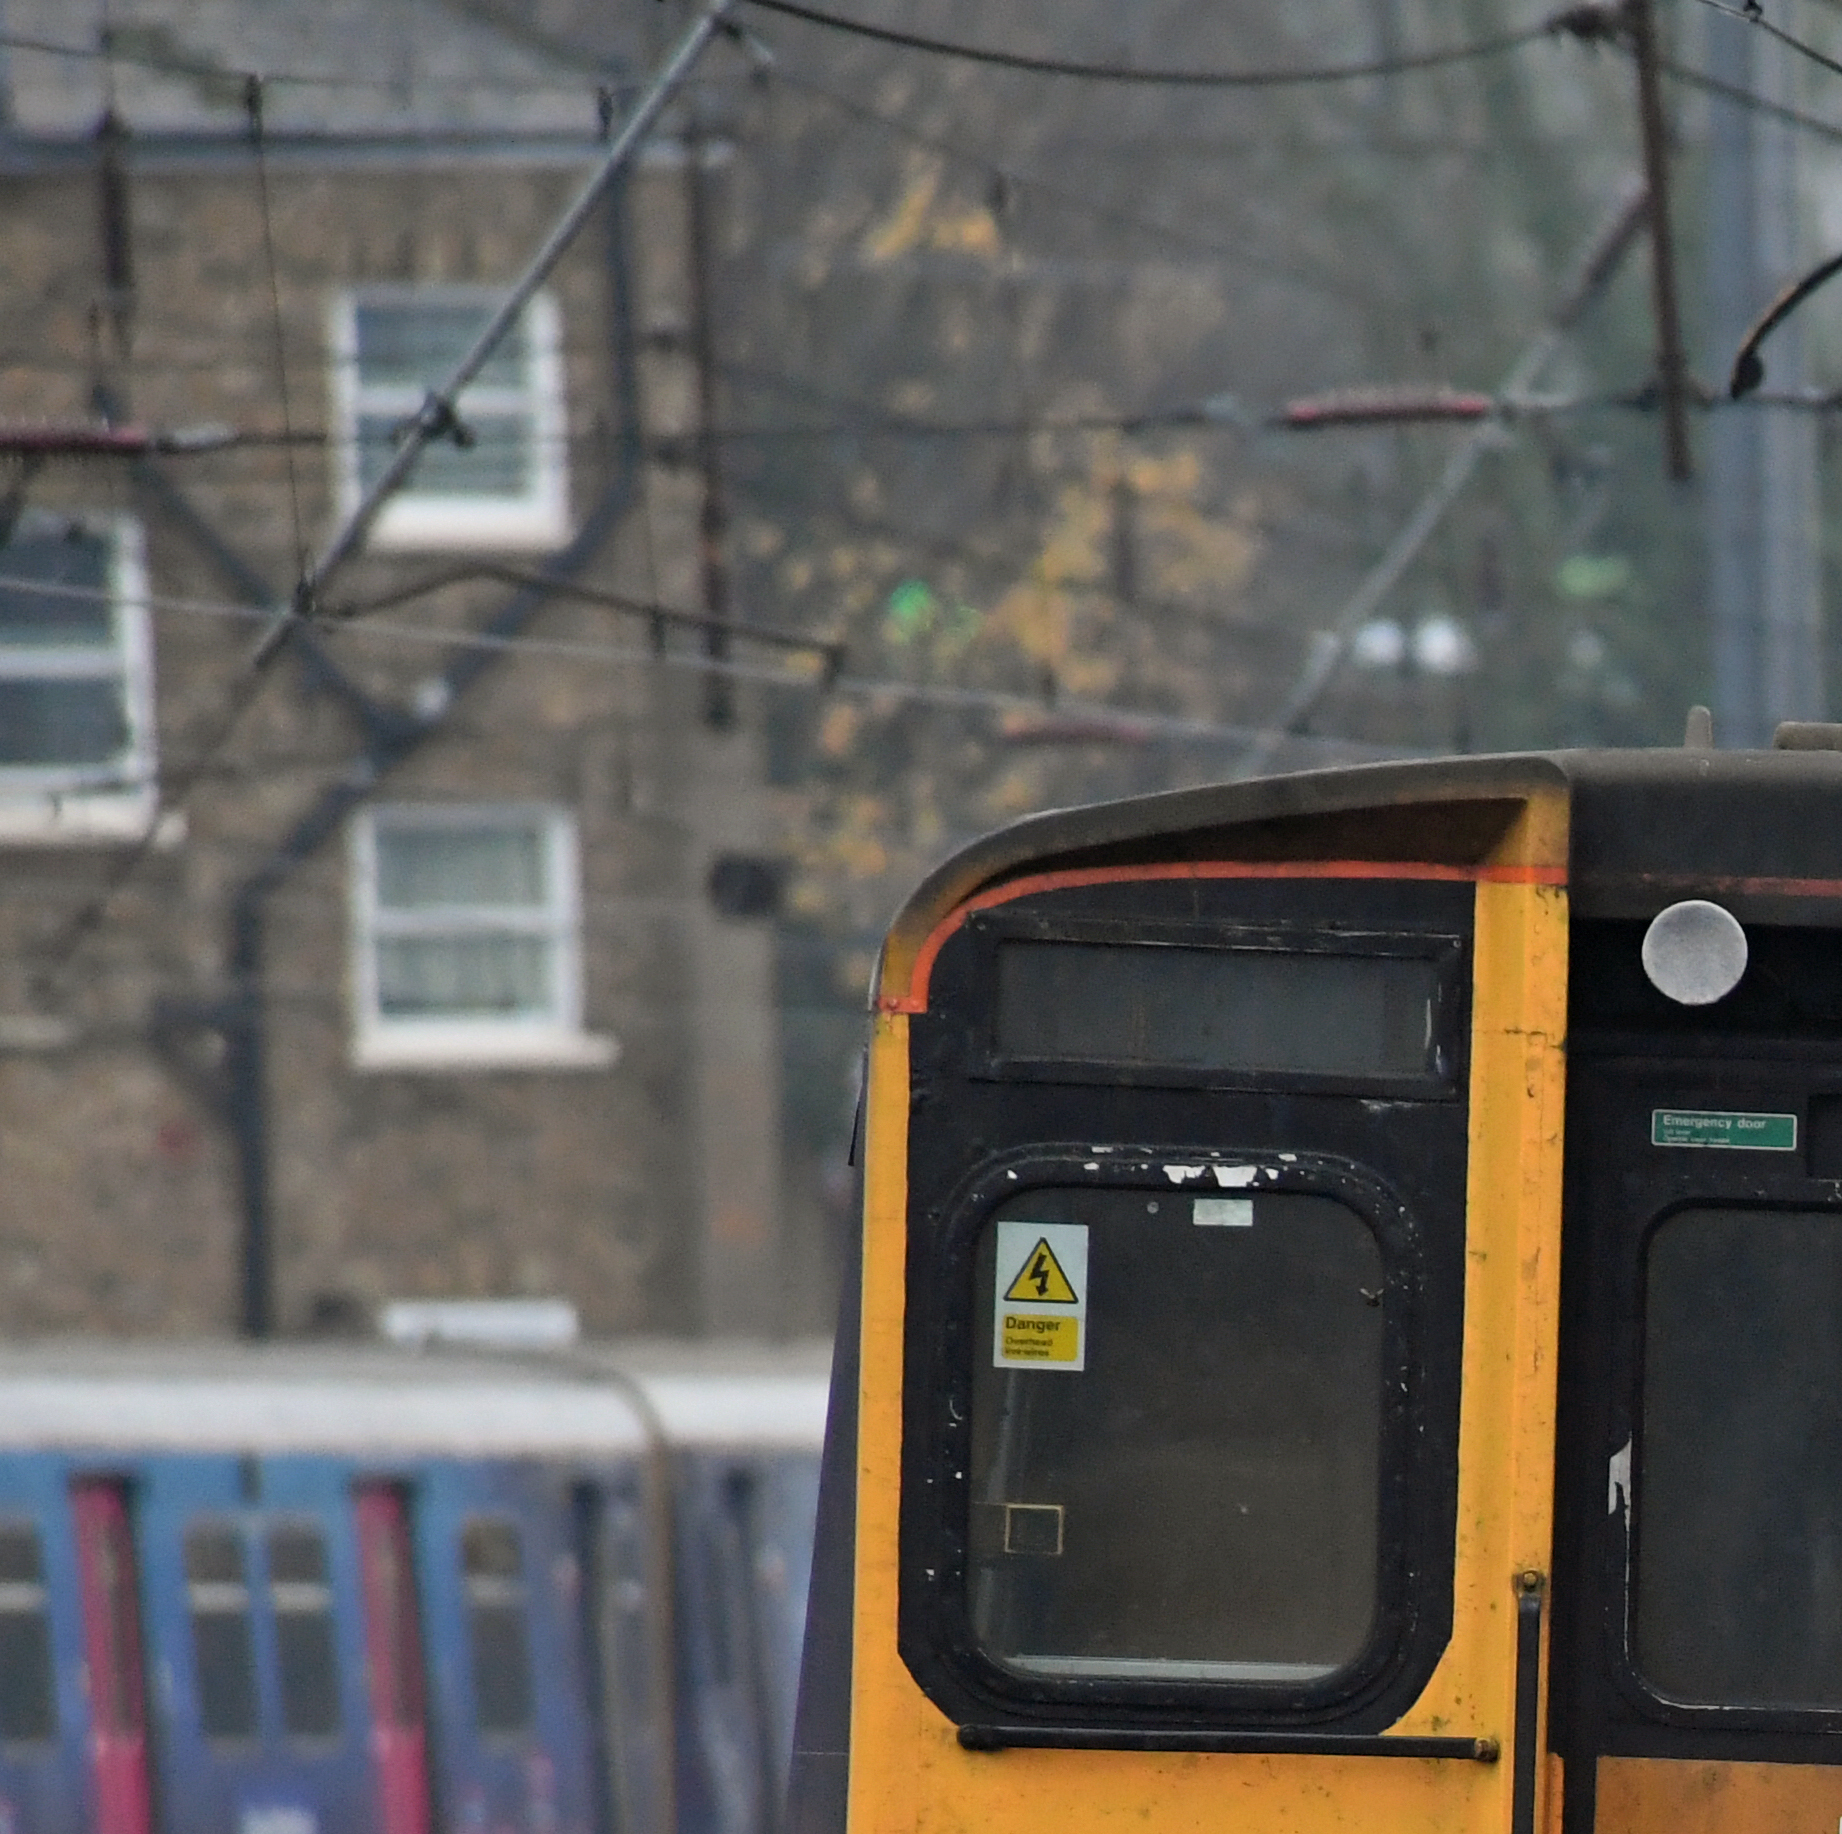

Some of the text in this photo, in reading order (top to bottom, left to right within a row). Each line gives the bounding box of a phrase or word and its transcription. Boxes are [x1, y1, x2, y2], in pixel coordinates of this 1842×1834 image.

[1663, 1114, 1767, 1129] Emergency door
[1005, 1316, 1061, 1333] Danger
